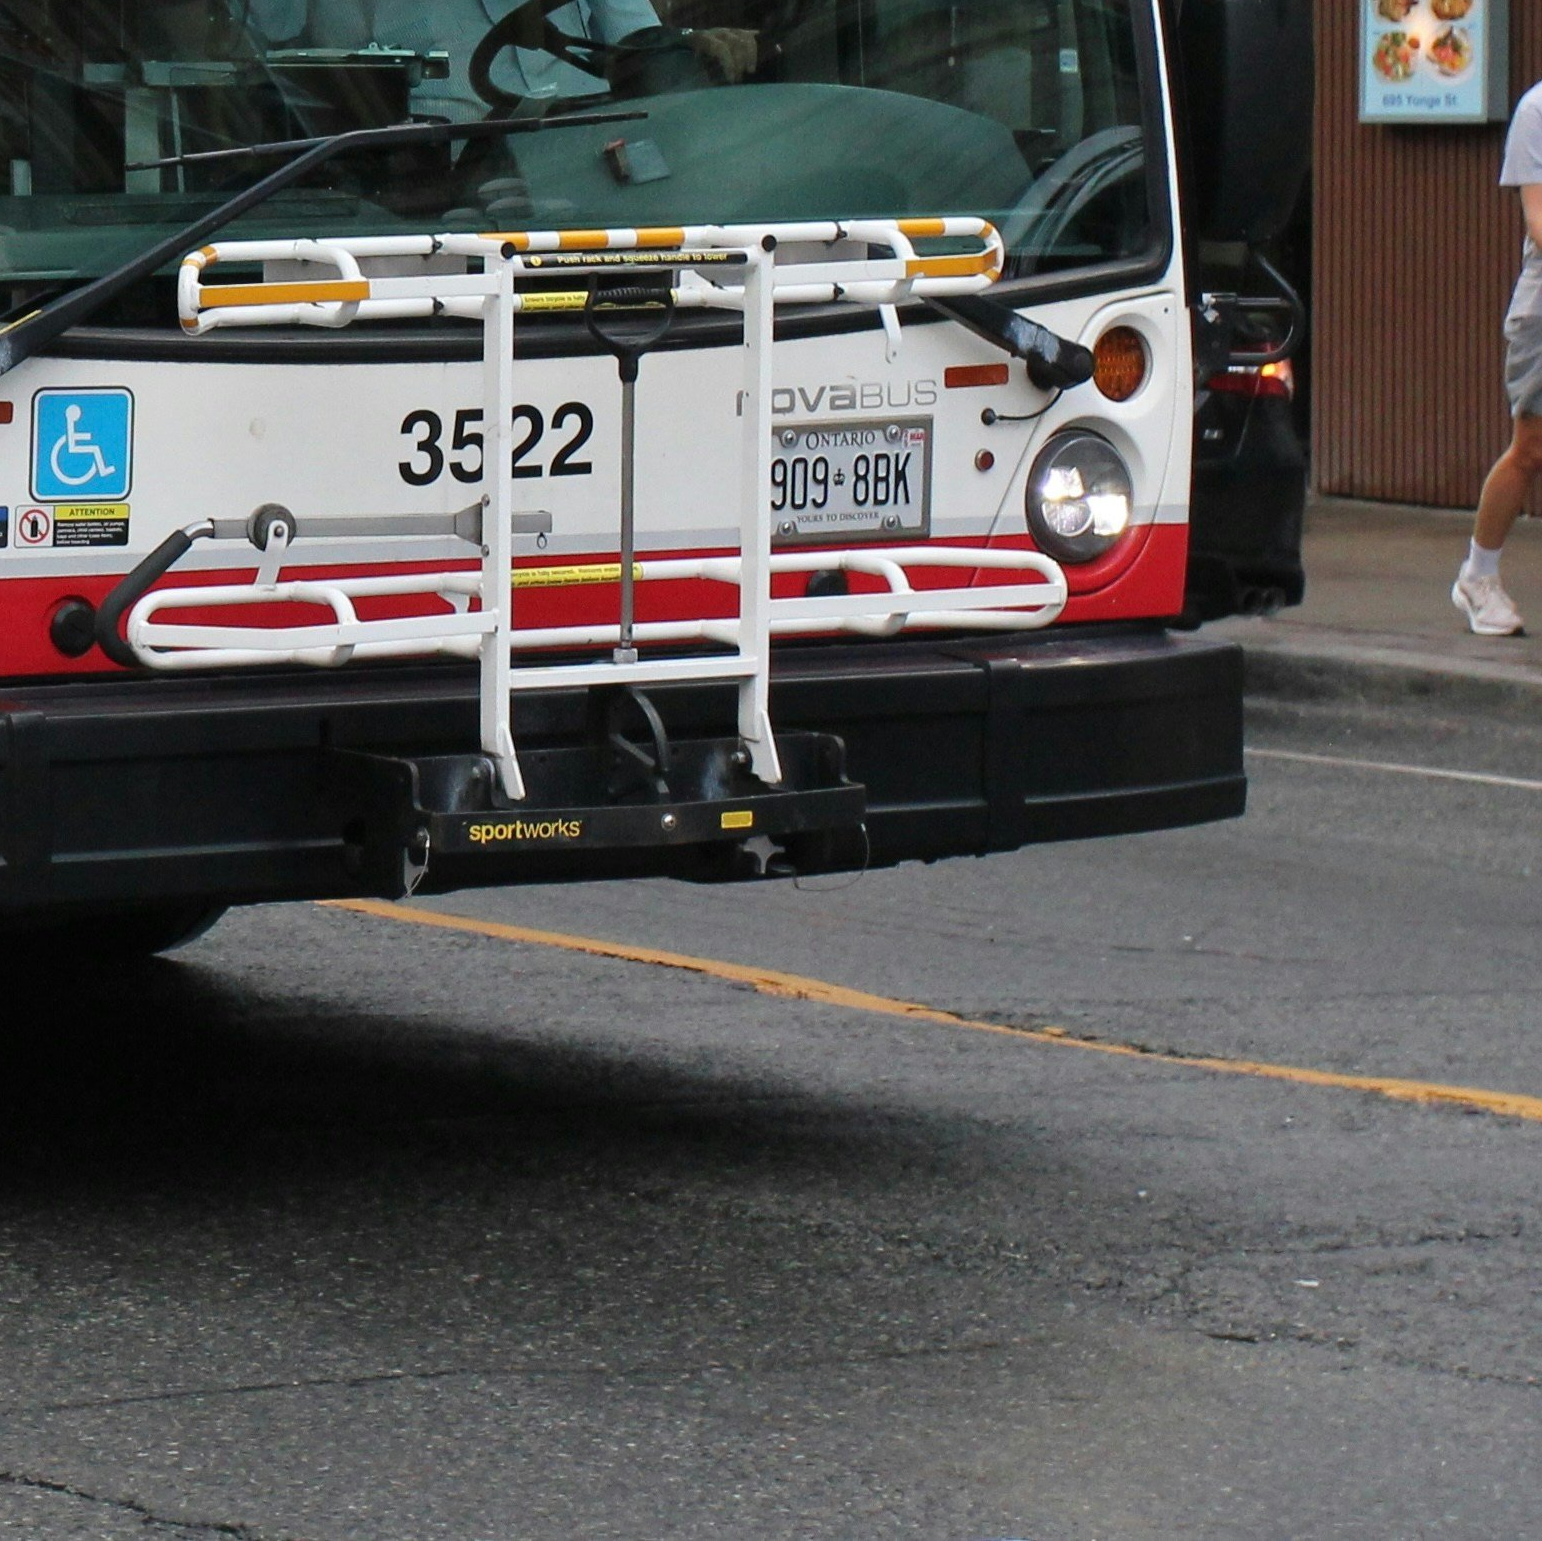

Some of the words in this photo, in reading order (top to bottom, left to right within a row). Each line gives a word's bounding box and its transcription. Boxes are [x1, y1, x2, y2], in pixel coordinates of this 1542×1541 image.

[557, 254, 581, 265] Push
[604, 253, 621, 263] and
[661, 252, 691, 263] handle
[692, 252, 702, 262] to
[704, 252, 728, 262] lower
[398, 401, 594, 486] 3522
[770, 456, 829, 510] 909
[853, 452, 913, 507] 8BK
[69, 508, 115, 516] ATTENTION
[797, 513, 823, 524] YOURS
[826, 513, 838, 523] TO
[839, 511, 880, 523] DISCOVER
[469, 818, 580, 844] sportworks
